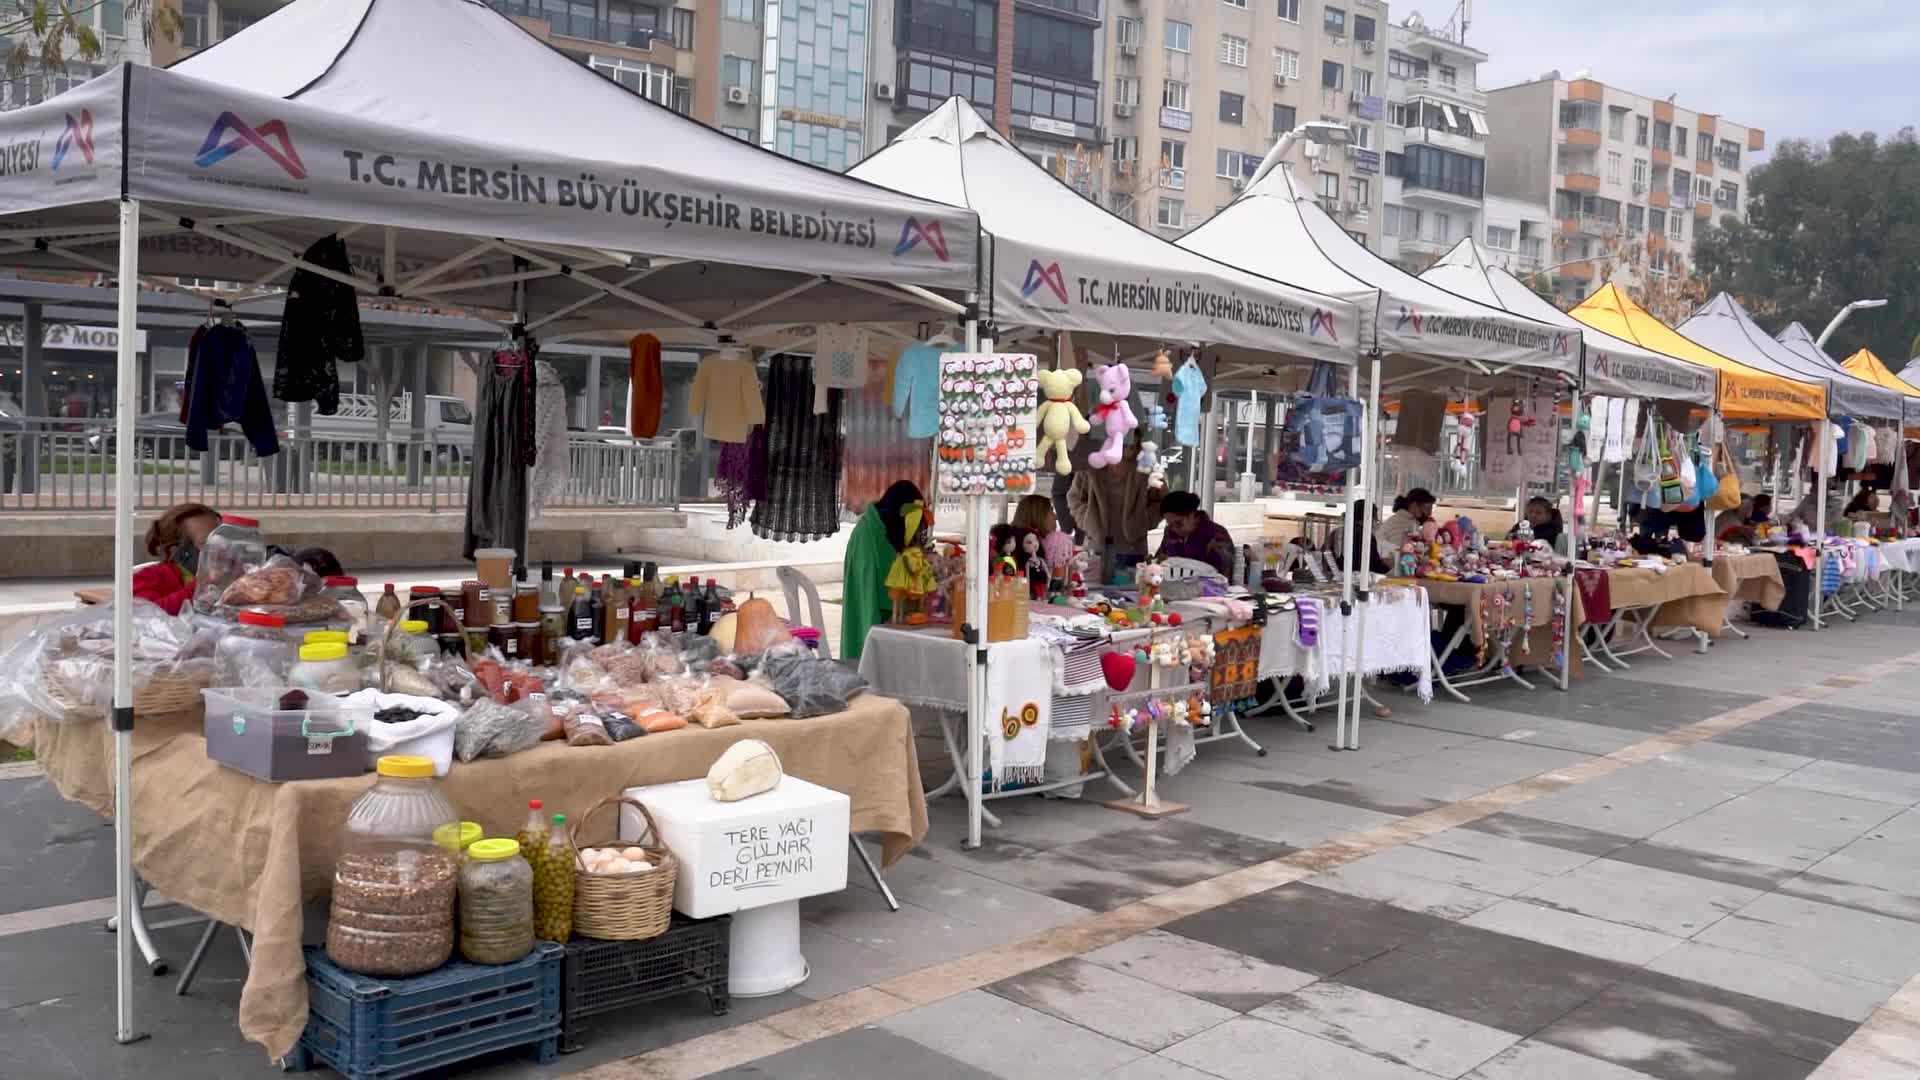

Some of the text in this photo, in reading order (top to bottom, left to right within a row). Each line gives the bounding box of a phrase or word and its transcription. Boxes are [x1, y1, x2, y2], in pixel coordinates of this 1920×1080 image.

[343, 150, 406, 188] T.C.
[417, 160, 547, 204] MERSİN
[557, 172, 742, 230] BÜYÜKŞEHİR
[750, 207, 876, 249] BELEDİYESİ
[1078, 277, 1305, 333] T.C. MERSİN BÜYÜKŞEHİR BELEDİYESİ
[723, 827, 769, 846] TERE
